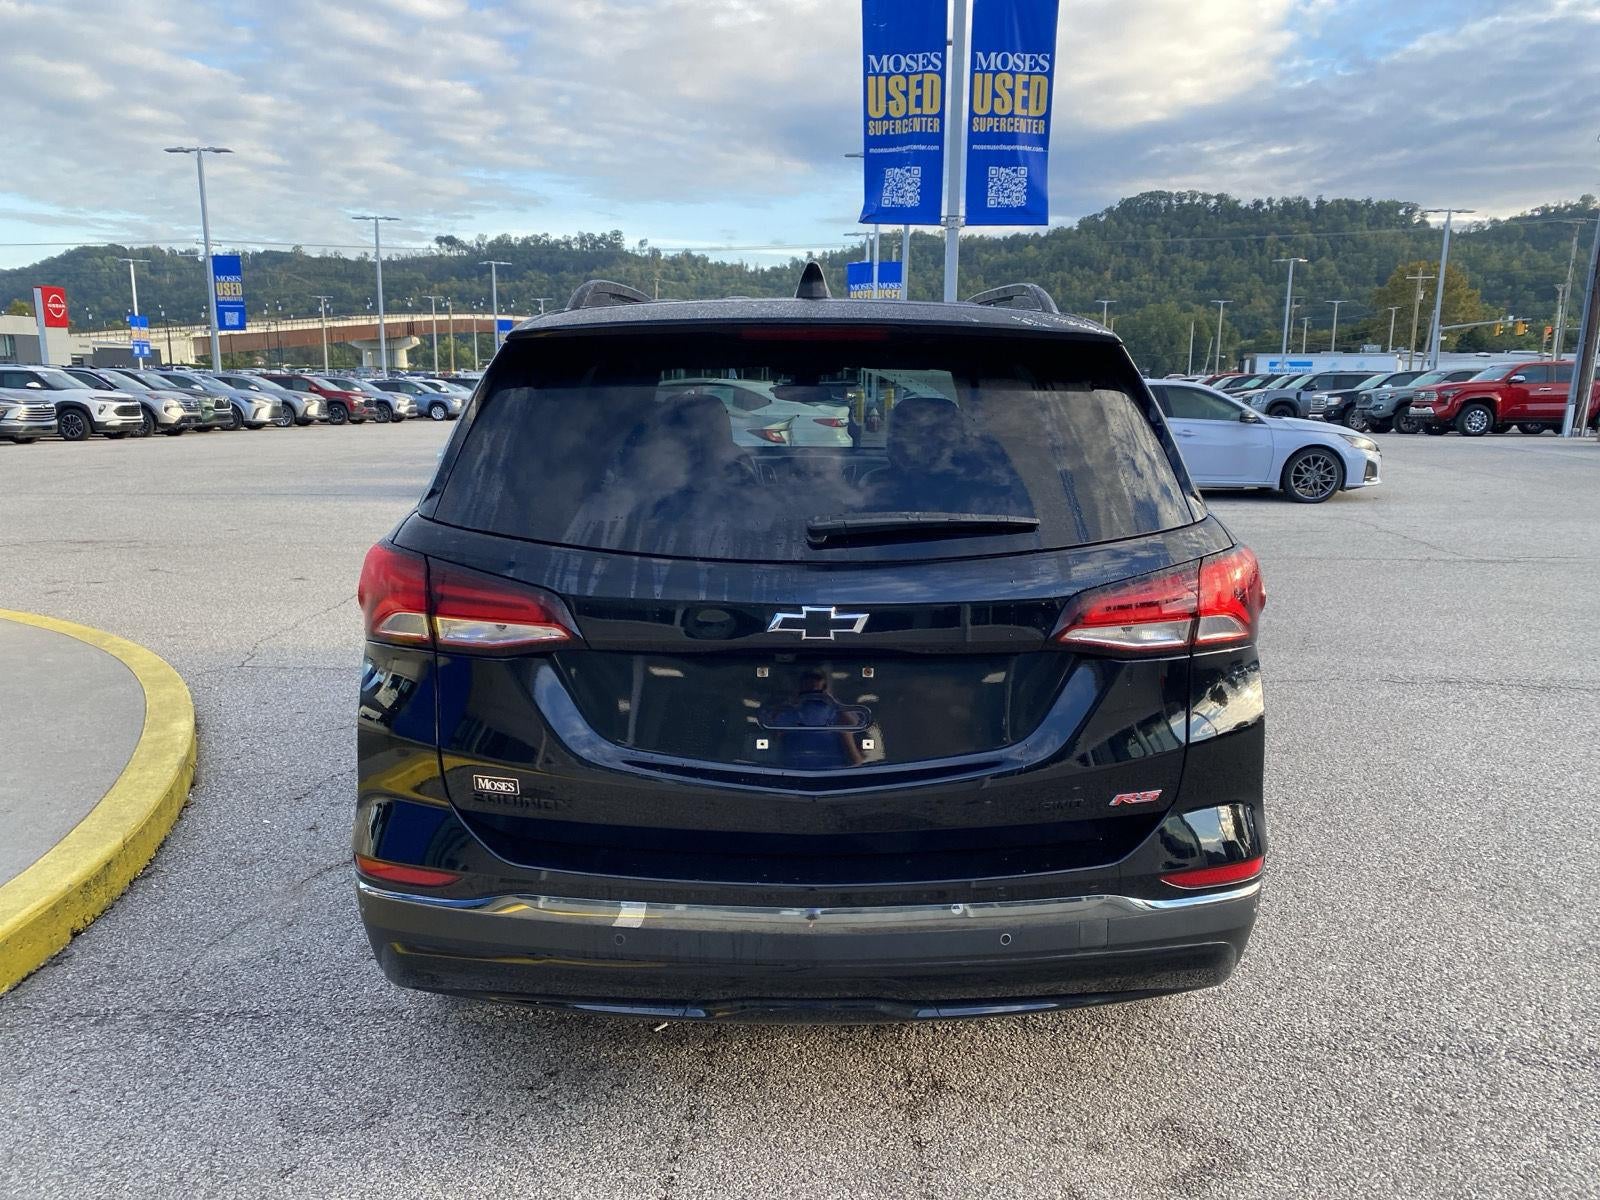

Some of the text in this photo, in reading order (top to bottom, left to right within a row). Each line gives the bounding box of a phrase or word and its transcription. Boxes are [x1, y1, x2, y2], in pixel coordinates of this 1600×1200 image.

[867, 52, 942, 74] MOSES
[974, 51, 1050, 73] MOSES
[867, 73, 942, 119] USED
[972, 72, 1049, 117] USED
[868, 117, 940, 136] SUPERCENTER
[972, 117, 1045, 135] SUPERCENTER
[869, 144, 940, 154] mosesusedsupercenter.com
[972, 144, 1045, 153] mosesusedsupercenter.com
[216, 282, 243, 296] USED
[850, 282, 874, 291] MOSES
[878, 281, 903, 290] MOSES
[478, 778, 515, 792] MOSES
[1109, 789, 1163, 807] RS
